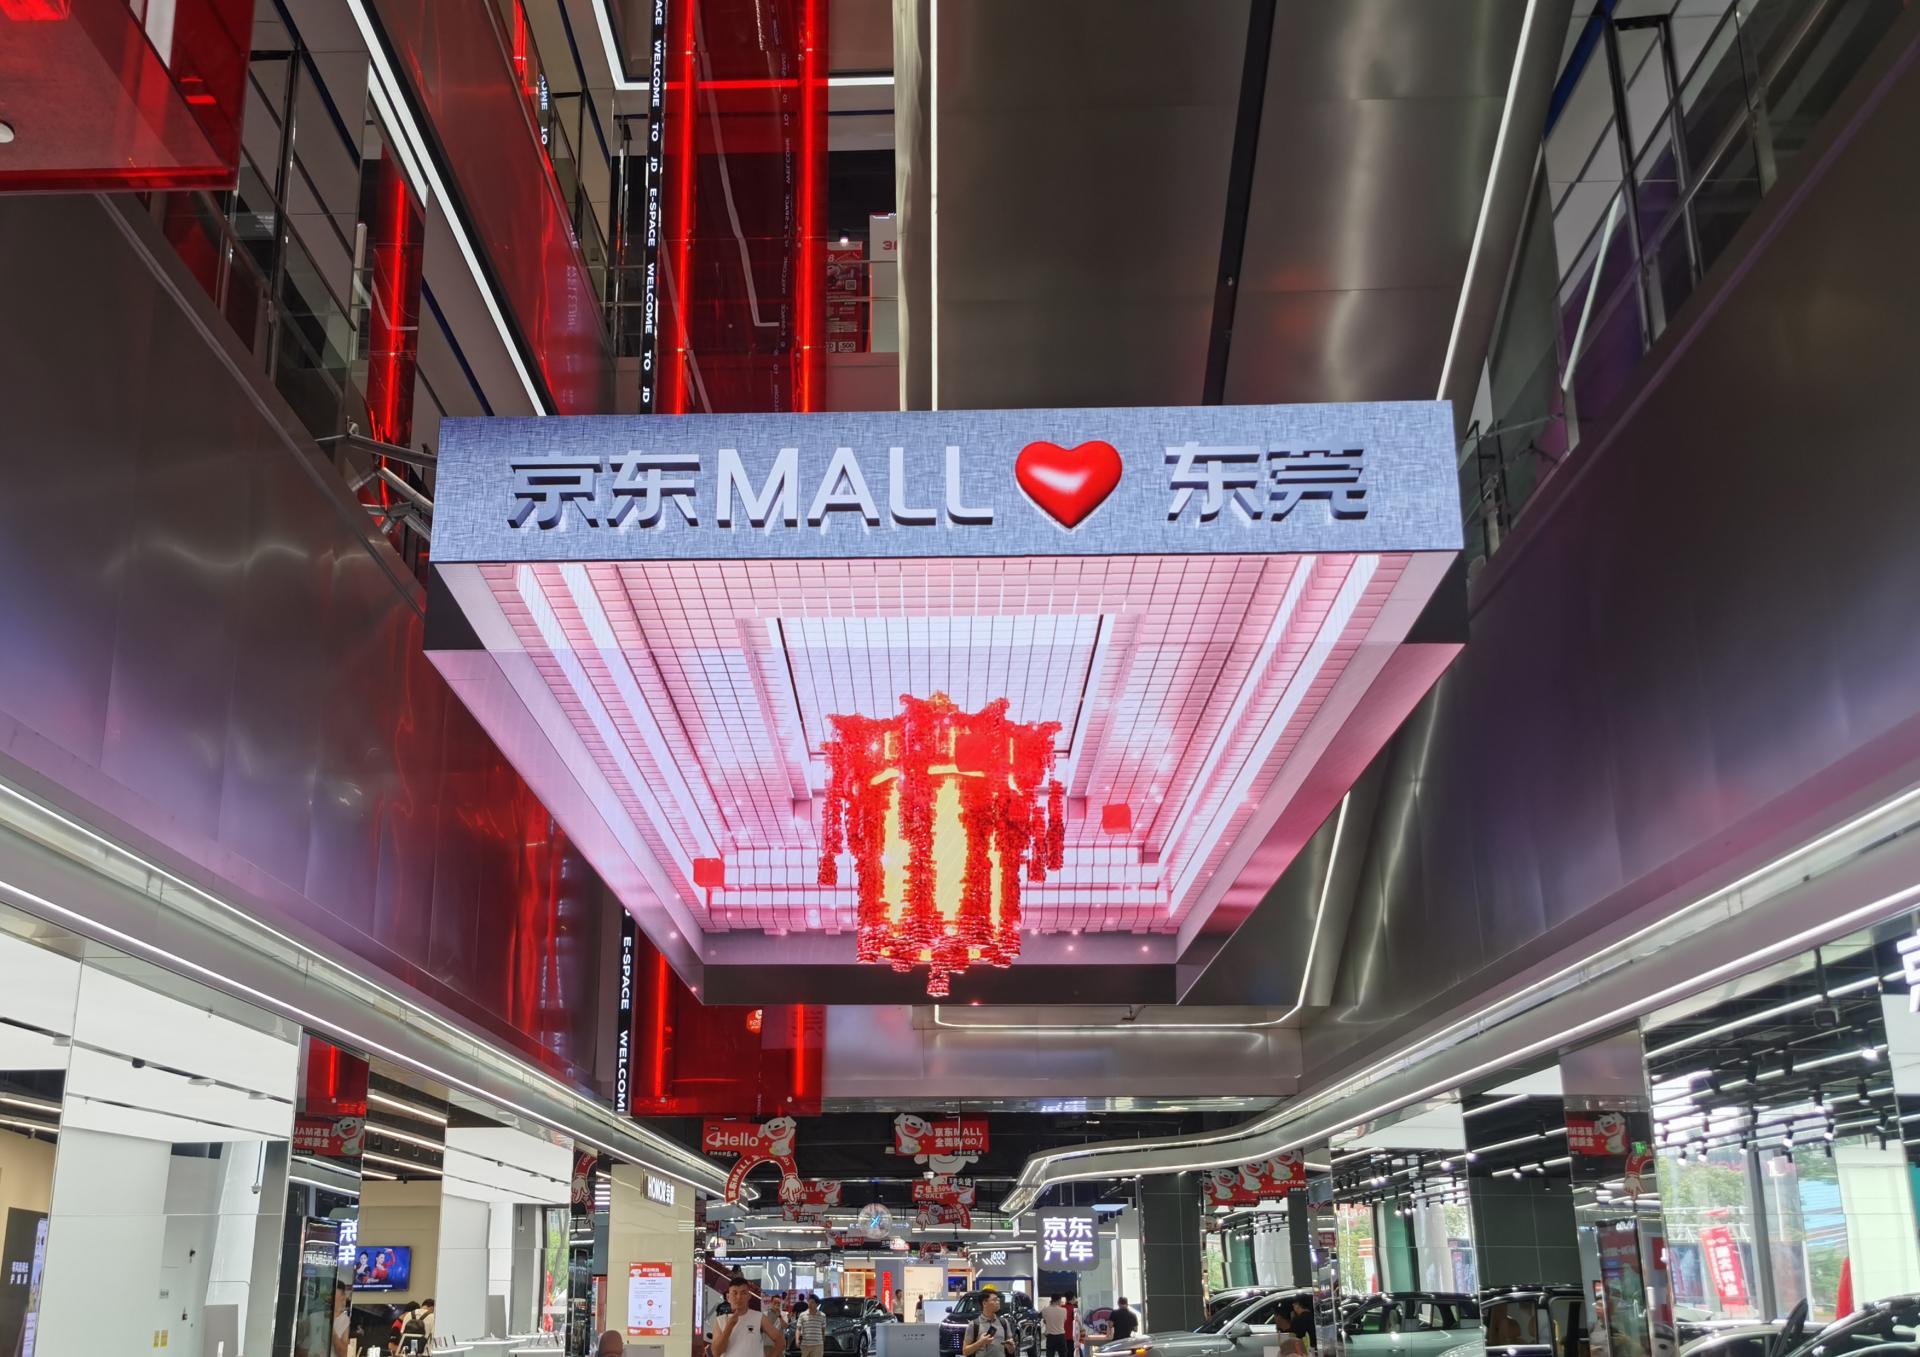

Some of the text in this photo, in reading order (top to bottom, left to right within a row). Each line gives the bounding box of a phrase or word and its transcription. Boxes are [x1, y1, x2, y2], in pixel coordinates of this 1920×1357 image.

[652, 40, 663, 107] WELCOME
[651, 122, 659, 142] TO
[650, 156, 658, 173] JD
[647, 188, 658, 247] E-SPACE
[645, 263, 655, 335] WELCOME
[643, 350, 653, 371] TO
[642, 386, 651, 403] JD
[508, 438, 1368, 530] 京东MALL 东莞
[621, 936, 632, 1010] E-SPACE
[1043, 1217, 1093, 1238] 京东
[1043, 1240, 1094, 1261] 汽车
